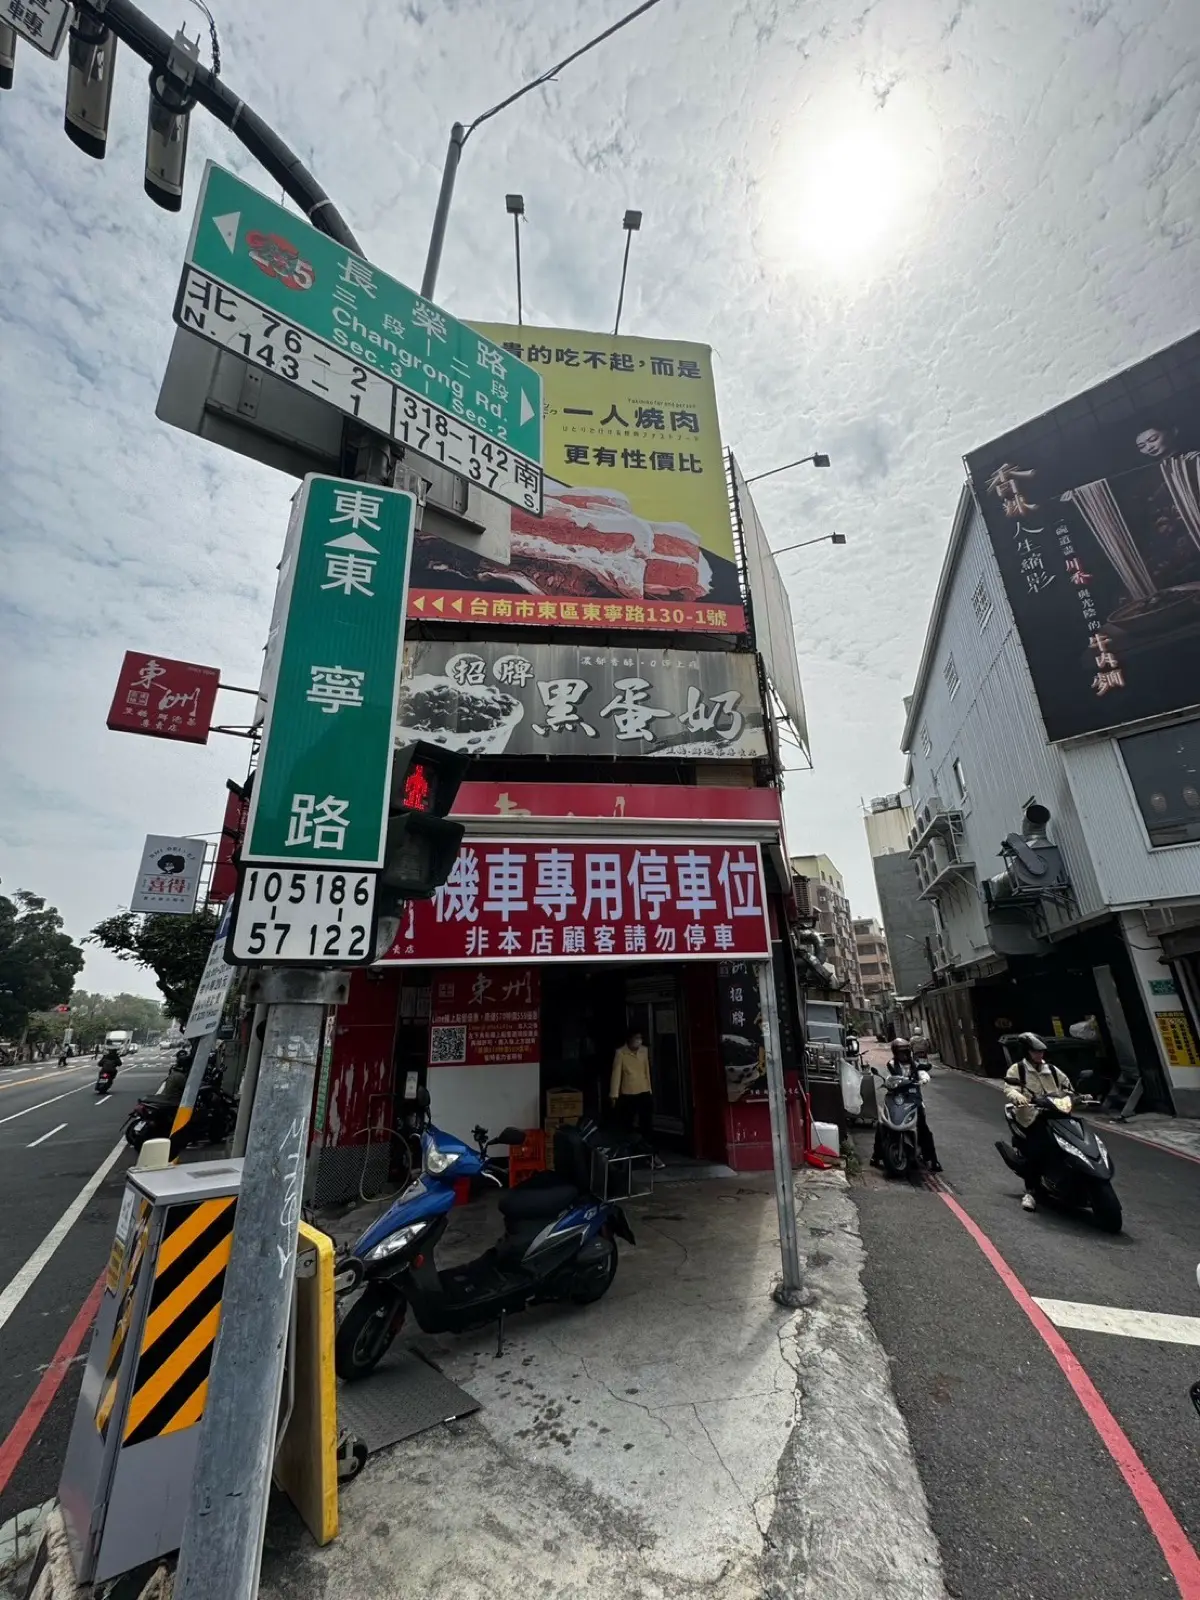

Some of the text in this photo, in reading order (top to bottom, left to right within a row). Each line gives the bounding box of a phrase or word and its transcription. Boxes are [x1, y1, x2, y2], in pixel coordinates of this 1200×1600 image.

[184, 305, 216, 336] N.
[187, 280, 238, 323] 北
[332, 285, 405, 340] 三段
[337, 256, 508, 380] 長榮路
[332, 307, 508, 422] Changrong Rd.
[450, 356, 509, 403] 二段
[514, 459, 538, 494] 南
[563, 443, 704, 474] 更有性價比
[329, 489, 384, 531] 東
[470, 597, 728, 626] 台南市東區東寧路130-1號
[454, 659, 534, 687] 招牌
[285, 552, 378, 851] 東寧路
[531, 677, 745, 743] 黑蛋奶
[250, 871, 370, 907] 105 186
[430, 846, 764, 923] 機車專用停車位
[247, 923, 366, 957] 57 122
[465, 923, 736, 956] 非本店顧客請勿停車
